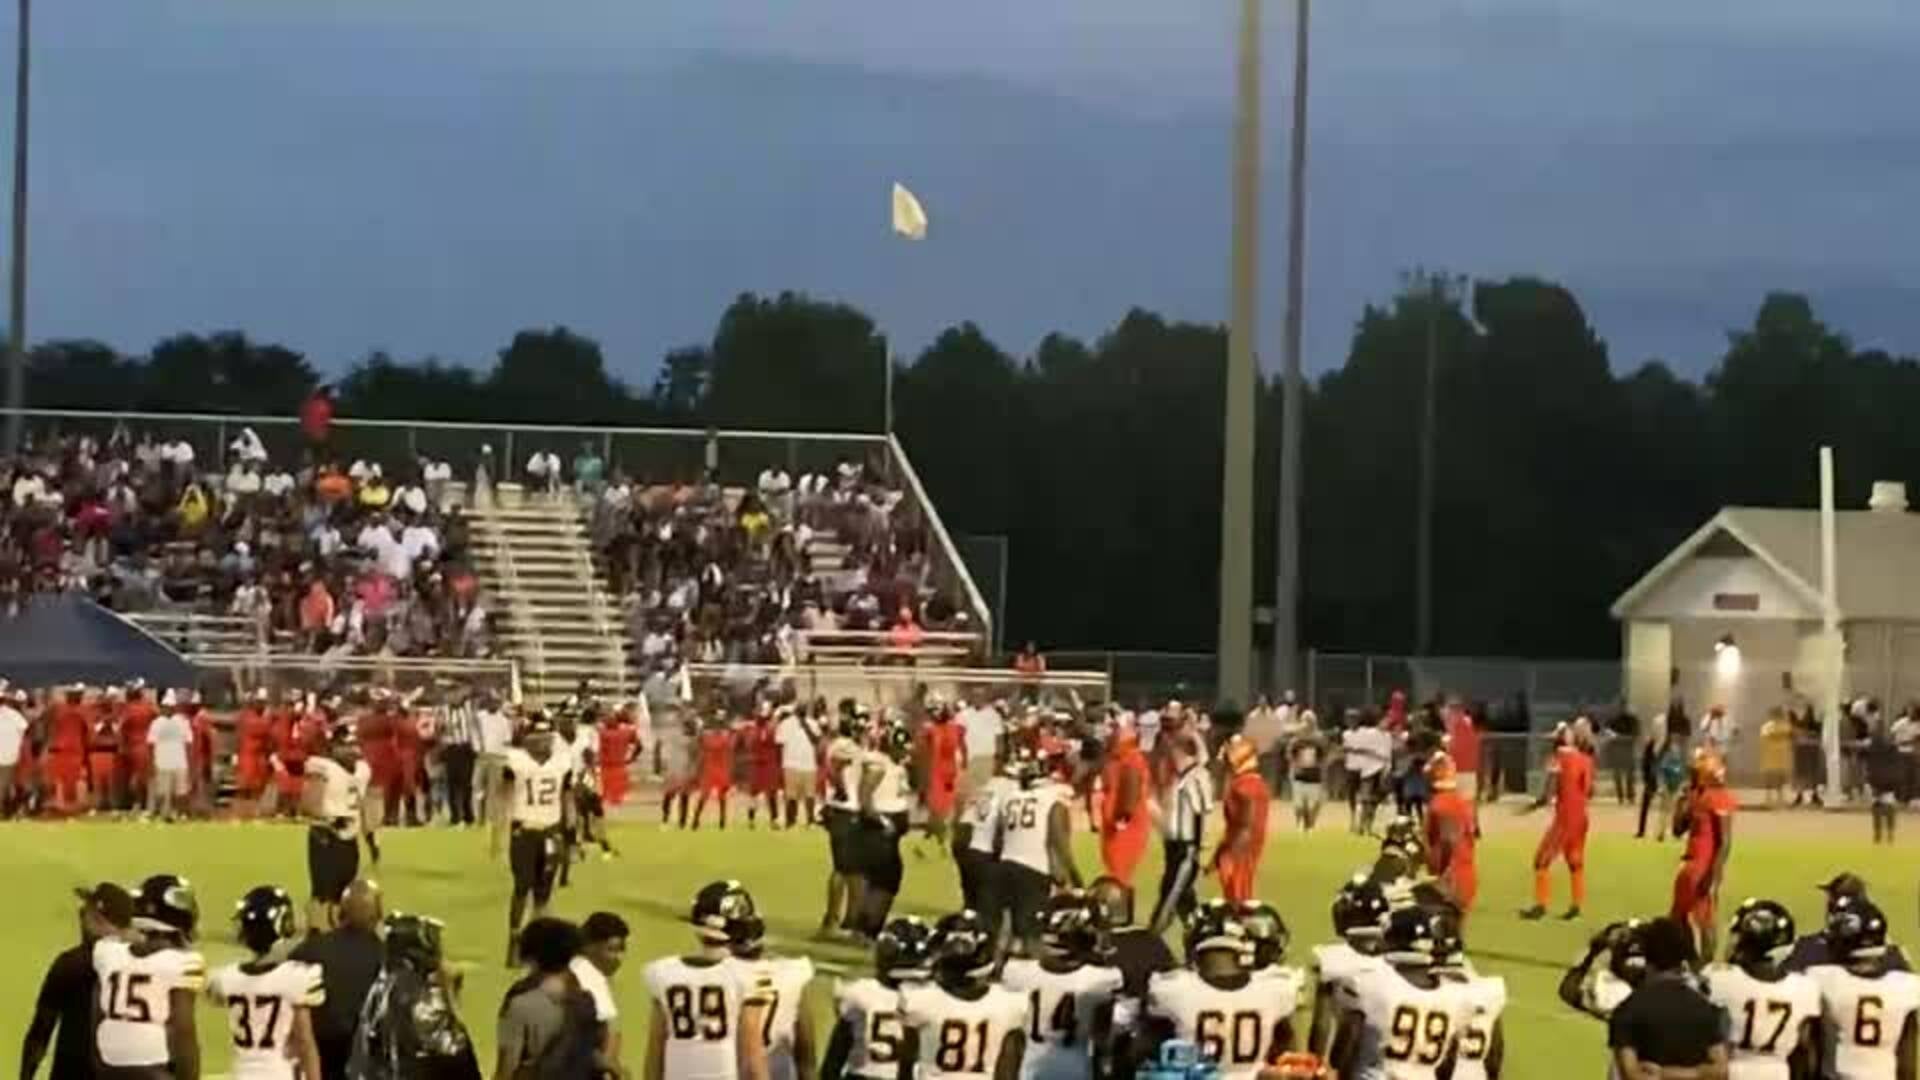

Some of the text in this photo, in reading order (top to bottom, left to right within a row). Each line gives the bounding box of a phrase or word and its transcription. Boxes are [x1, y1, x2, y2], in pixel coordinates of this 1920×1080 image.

[525, 777, 556, 805] 12
[109, 972, 152, 1022] 15
[228, 994, 282, 1048] 37
[667, 984, 728, 1040] 89
[1030, 988, 1077, 1047] 14
[1855, 995, 1883, 1046] 6
[936, 1017, 989, 1073] 81
[1197, 1009, 1261, 1064] 60
[1385, 1004, 1449, 1065] 99
[1739, 998, 1792, 1051] 17
